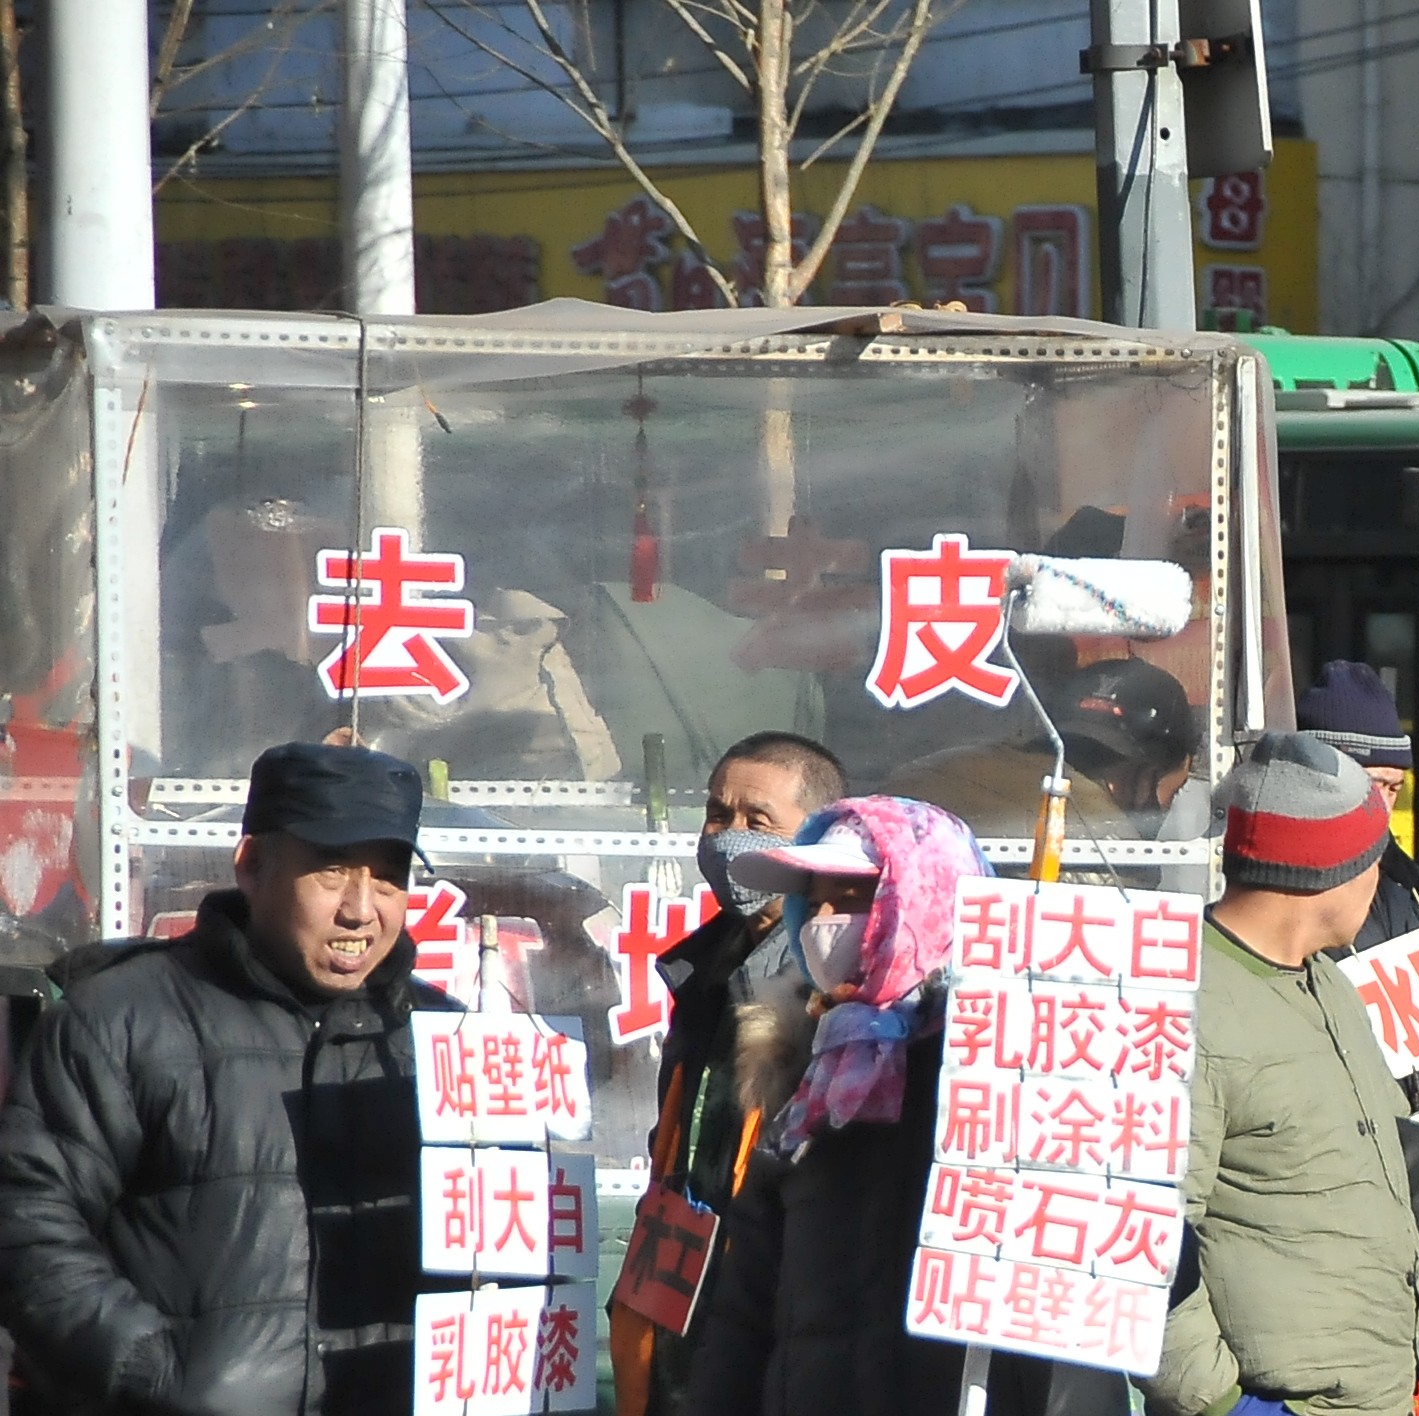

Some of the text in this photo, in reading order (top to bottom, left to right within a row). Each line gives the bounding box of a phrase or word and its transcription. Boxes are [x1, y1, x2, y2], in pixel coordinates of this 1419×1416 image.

[959, 893, 1200, 983] 刮大白
[431, 1030, 576, 1119] 贴壁纸
[948, 988, 1192, 1081] 乳胶漆
[939, 1078, 1188, 1176] 刷涂料
[442, 1165, 583, 1254] 刮大白
[930, 1166, 1179, 1275] 喷石灰
[428, 1303, 580, 1404] 乳胶漆
[914, 1250, 1153, 1364] 贴壁纸
